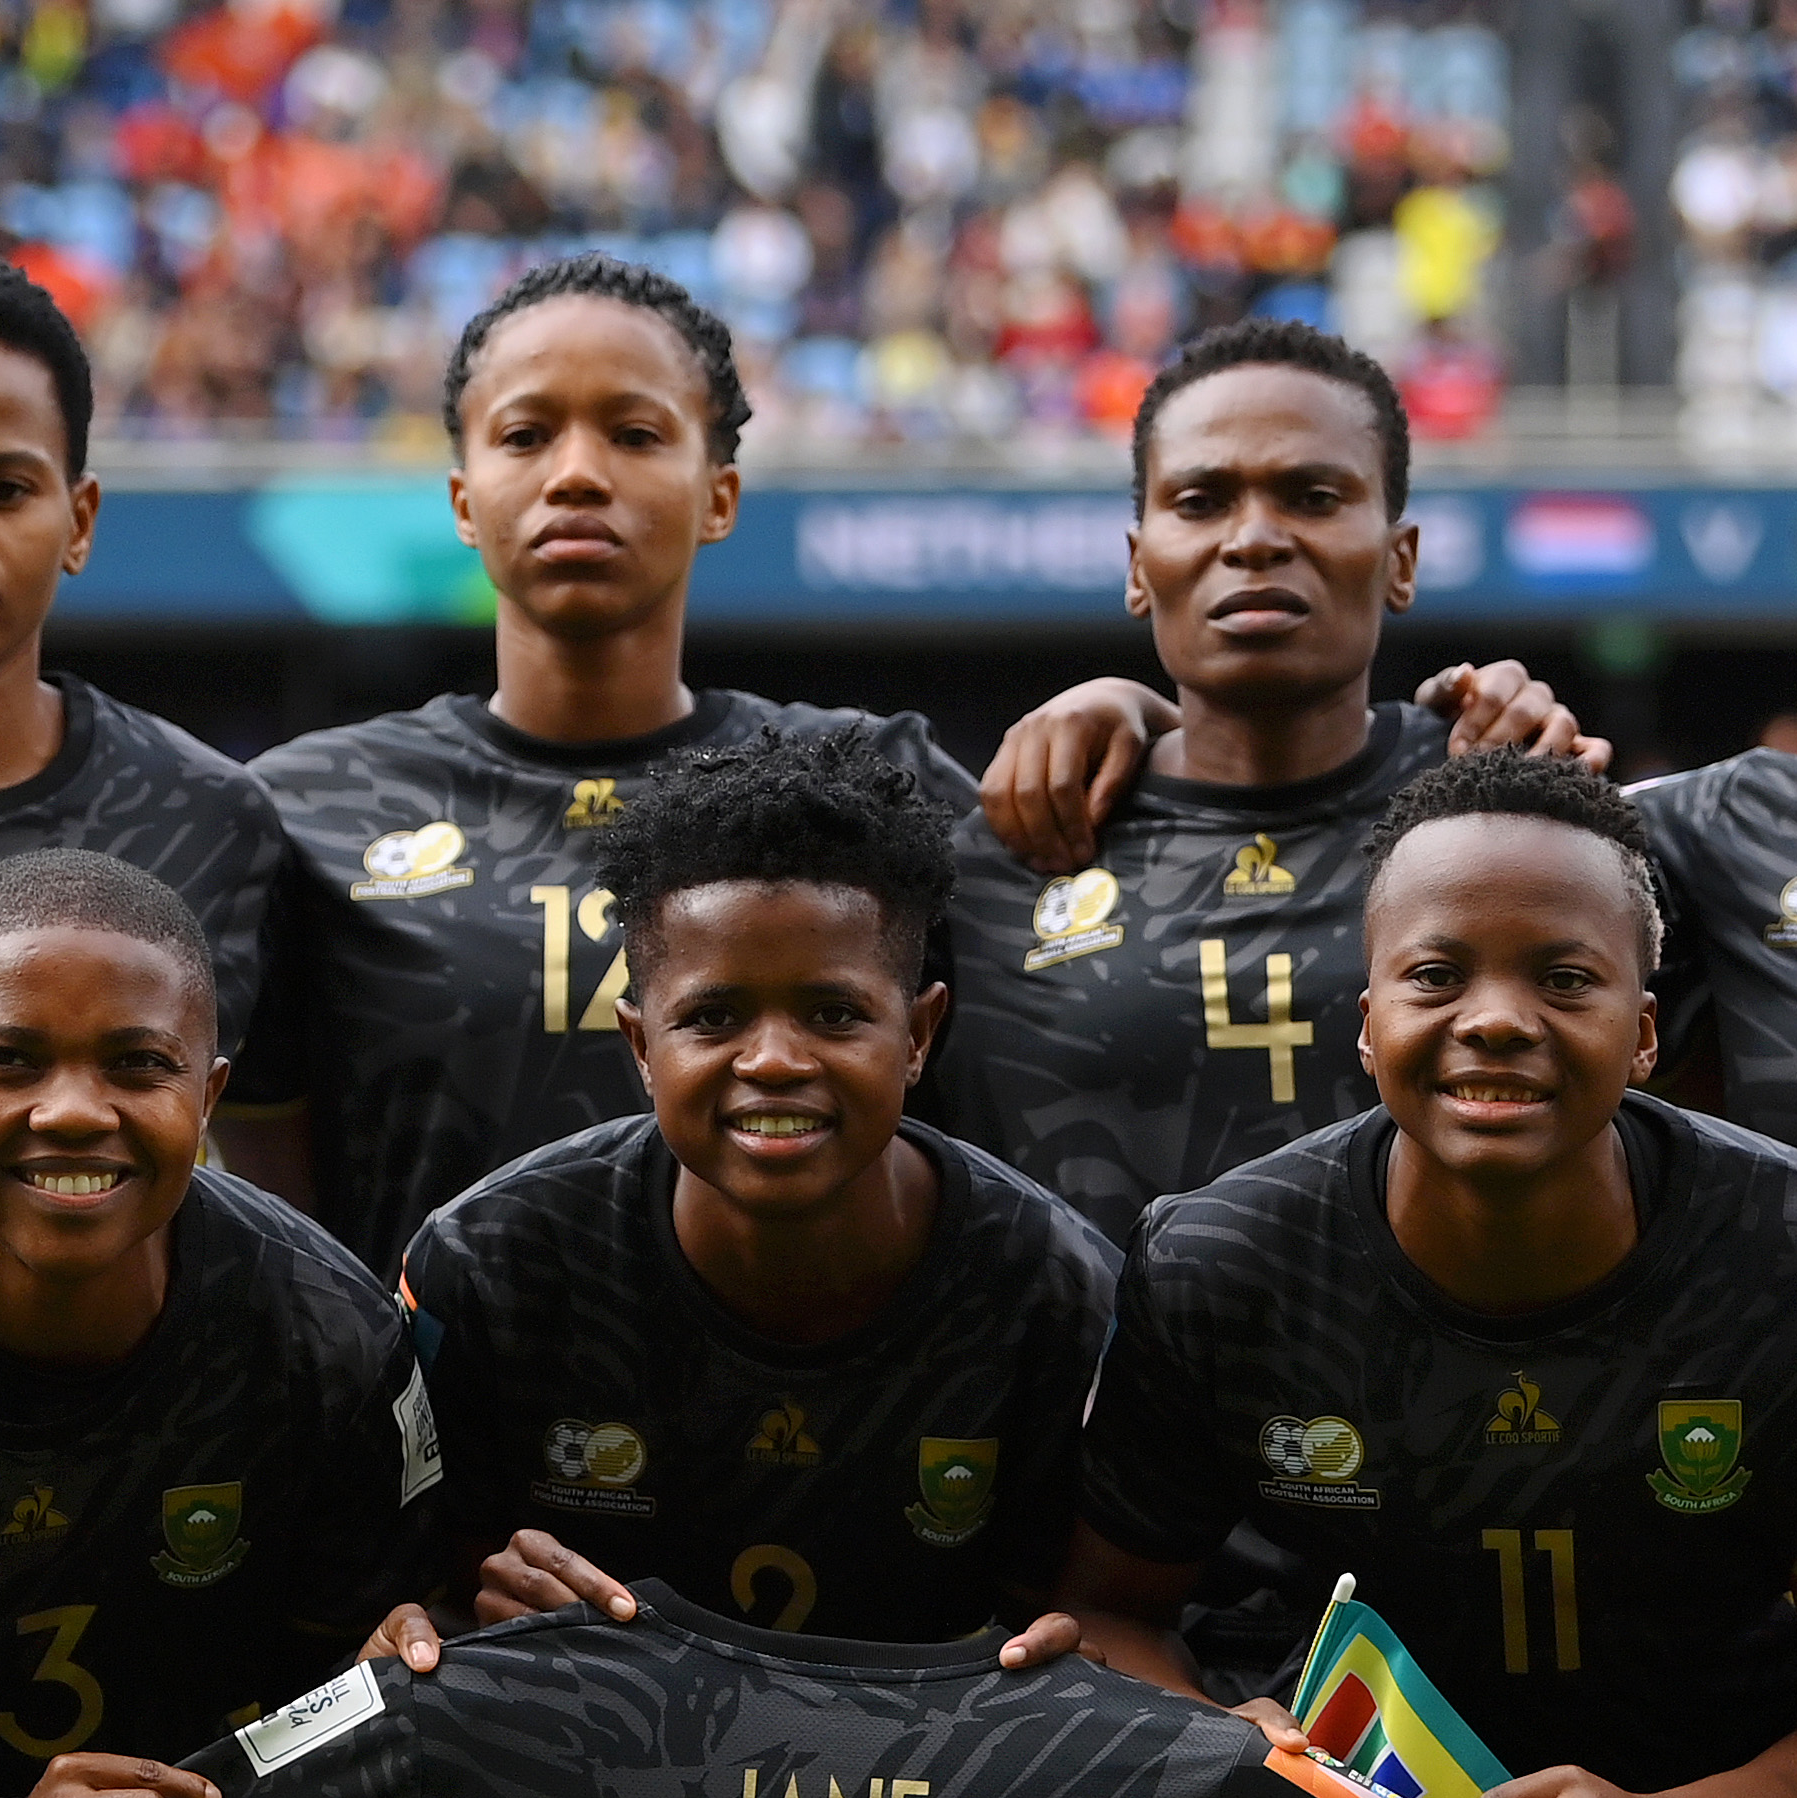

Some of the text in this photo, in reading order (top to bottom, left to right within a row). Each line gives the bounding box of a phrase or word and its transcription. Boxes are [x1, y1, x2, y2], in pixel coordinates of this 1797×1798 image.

[530, 885, 630, 1034] 12
[1200, 938, 1313, 1103] 4
[1264, 1487, 1375, 1505] FOOTBALL ASSOCIATION
[1279, 1482, 1355, 1495] SOUTH AFRICAN
[1663, 1491, 1737, 1509] SOUTH AFRICA
[1482, 1528, 1582, 1673] 11
